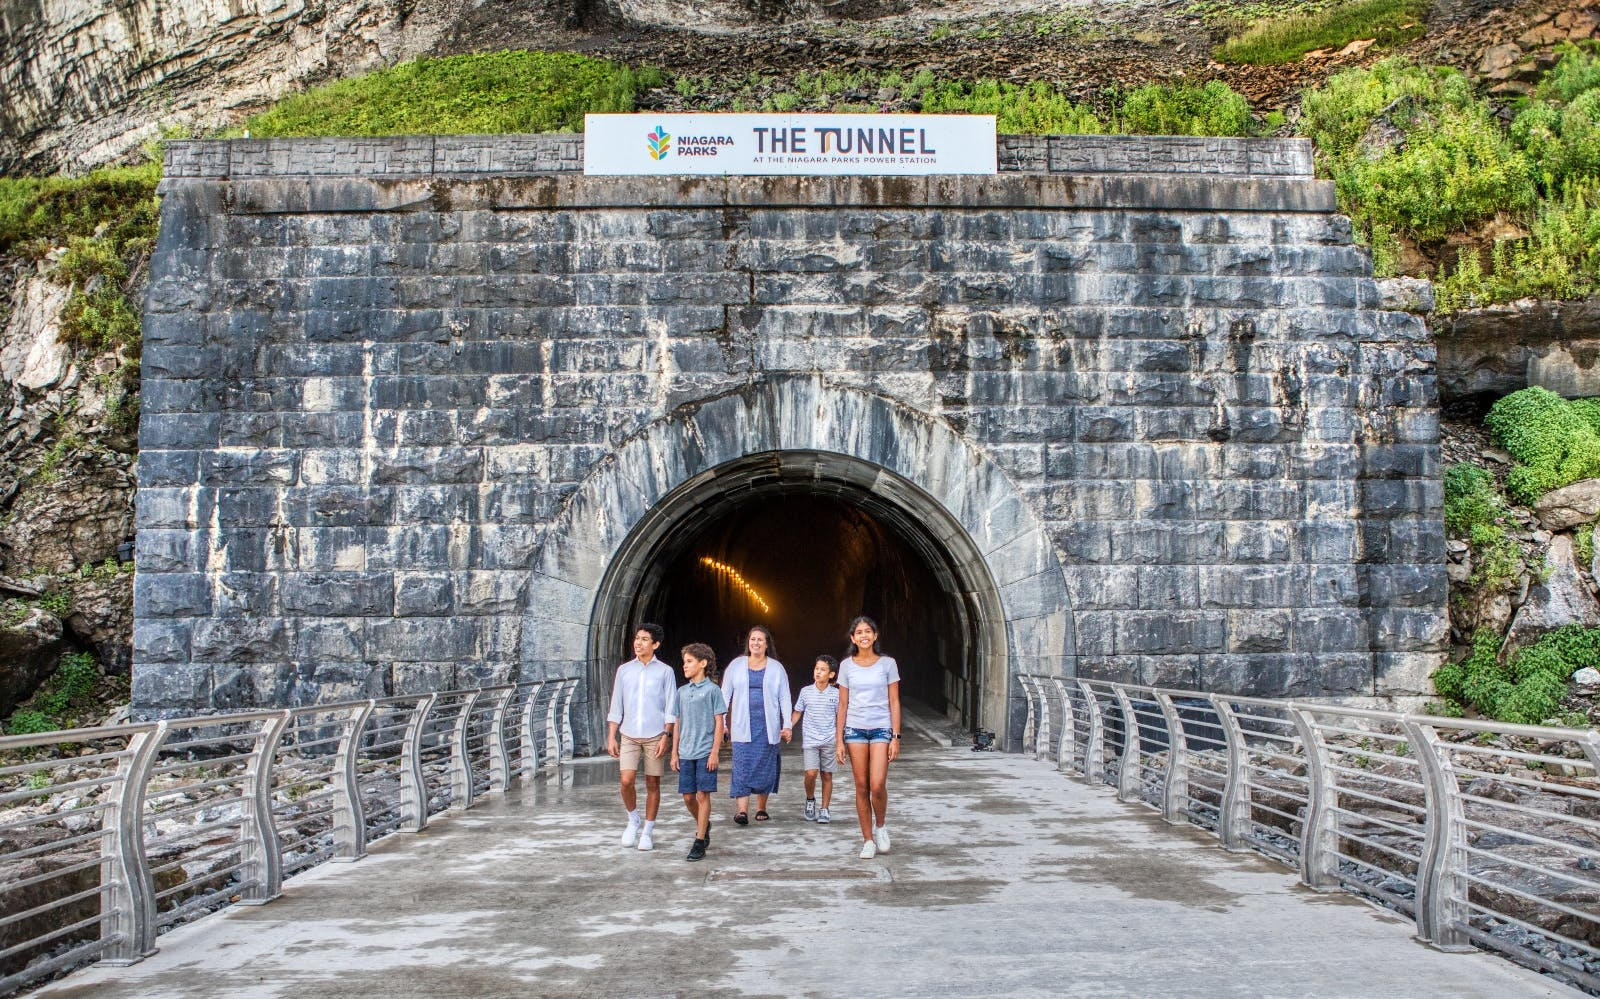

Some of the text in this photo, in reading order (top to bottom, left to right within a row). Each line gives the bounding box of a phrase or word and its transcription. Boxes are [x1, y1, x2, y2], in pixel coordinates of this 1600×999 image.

[677, 136, 735, 146] NIAGARA
[753, 127, 936, 155] THE TUNNEL
[677, 146, 718, 156] PARKS
[753, 156, 937, 164] AT THE NIAGARA PARKS POWER STATION
